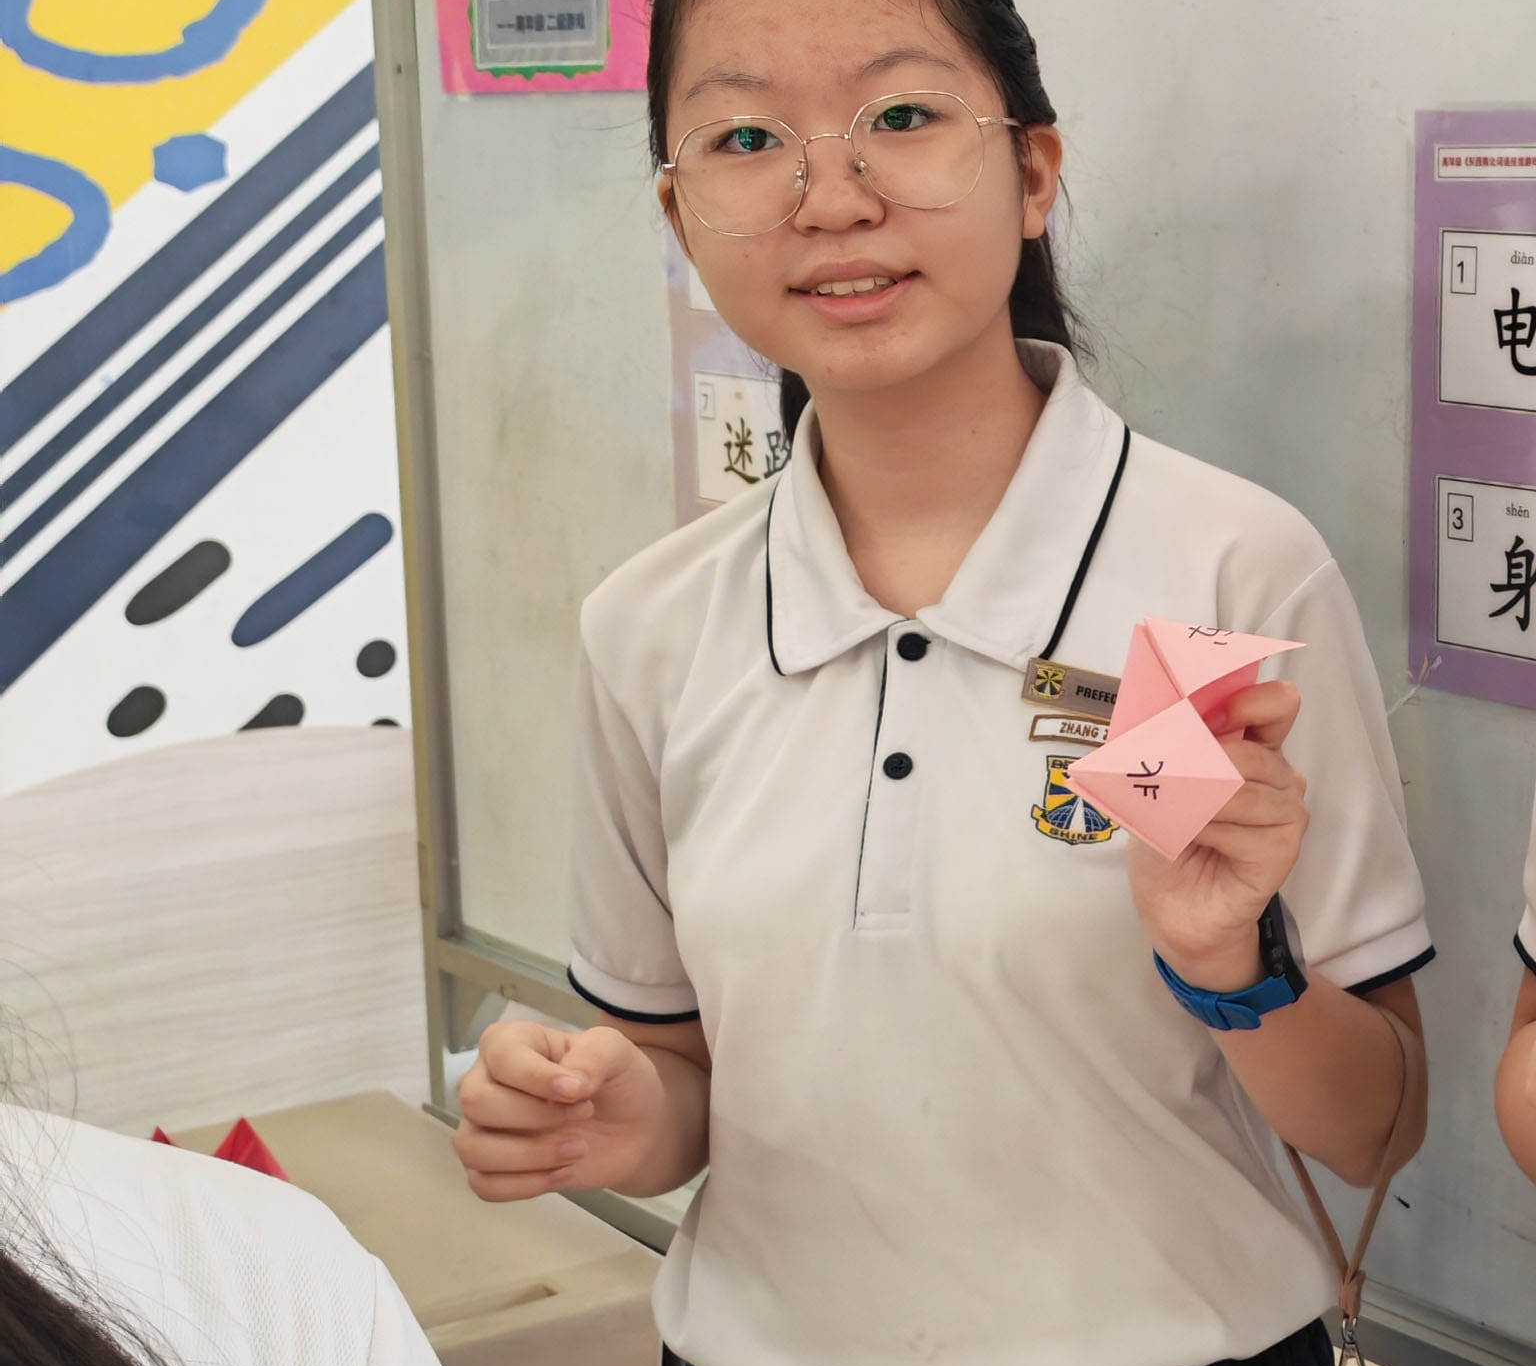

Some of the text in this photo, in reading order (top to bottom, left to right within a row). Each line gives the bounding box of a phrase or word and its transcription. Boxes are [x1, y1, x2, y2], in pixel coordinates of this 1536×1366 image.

[1457, 261, 1465, 283] 1
[1452, 507, 1464, 530] 3
[1076, 685, 1117, 705] PREFEC
[1059, 721, 1099, 739] ZHANG
